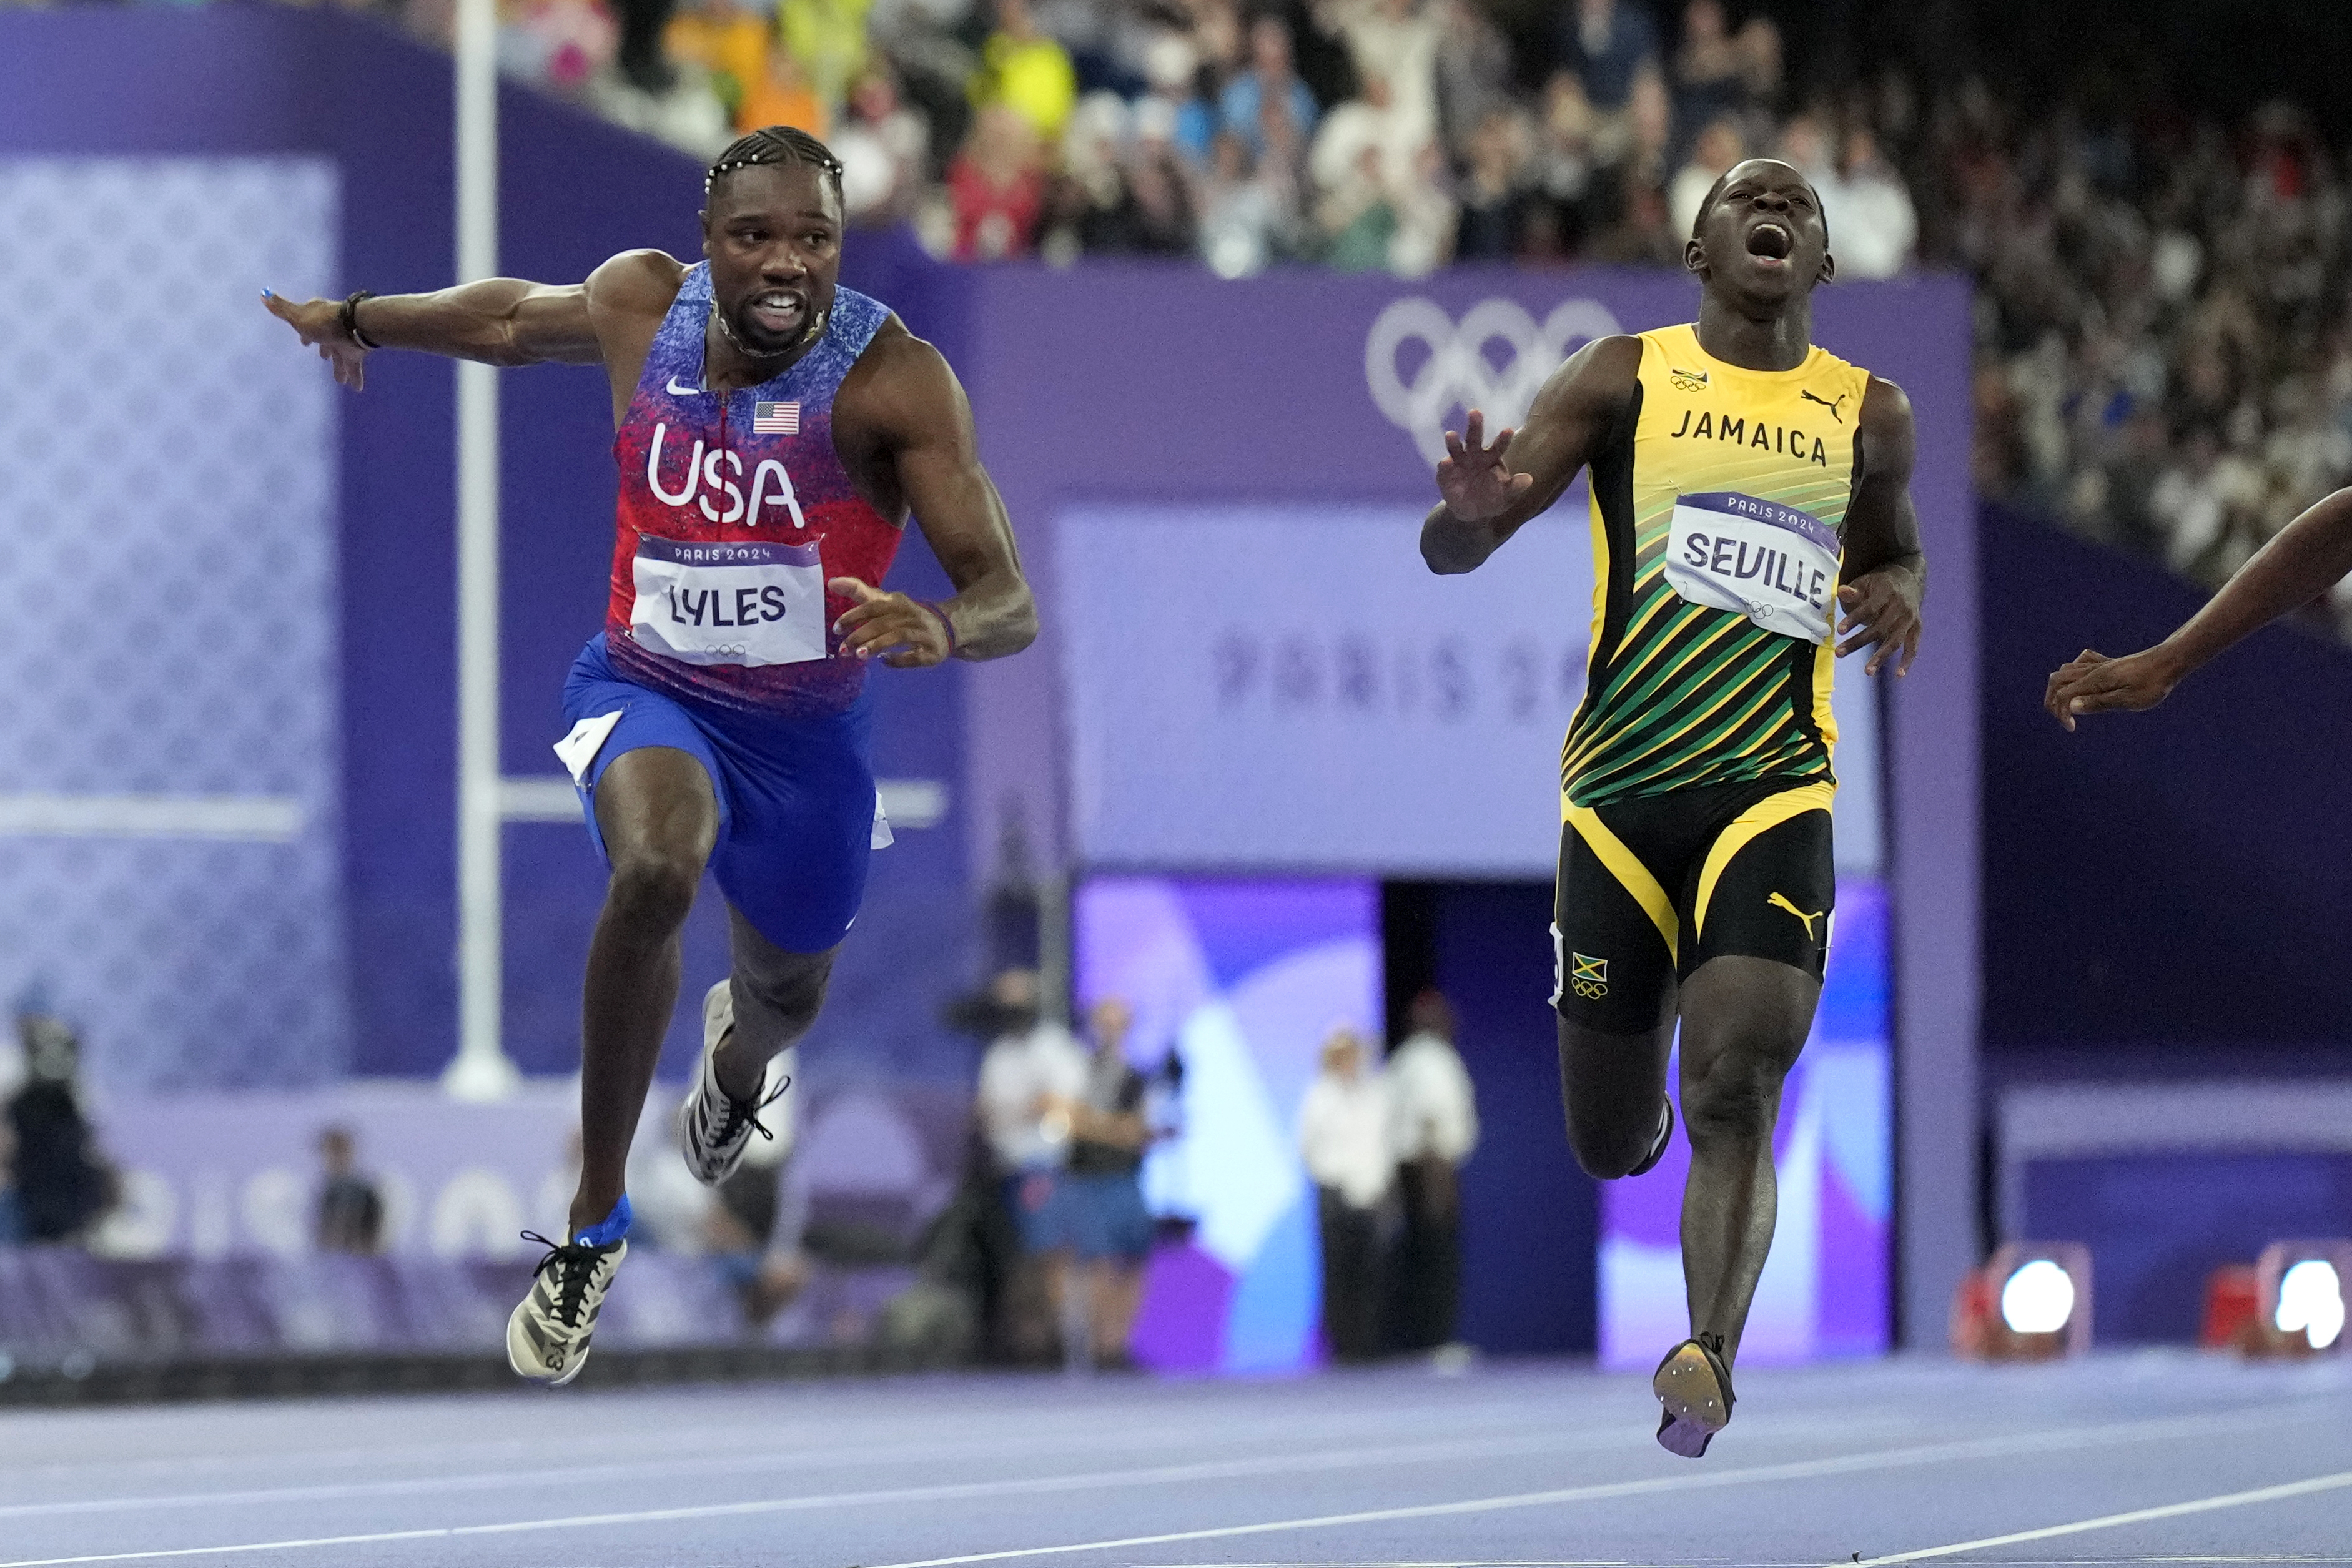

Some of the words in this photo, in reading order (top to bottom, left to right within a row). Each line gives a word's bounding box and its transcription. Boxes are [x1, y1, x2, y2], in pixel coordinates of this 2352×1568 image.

[1670, 410, 1826, 468] JAMAICA
[648, 422, 806, 529] USA
[1727, 496, 1774, 518] PARIS
[1779, 511, 1814, 534] 2024
[674, 547, 719, 561] PARIS
[726, 547, 771, 560] 2024
[1683, 532, 1826, 611] SEVILLE
[668, 584, 786, 627] LYLES
[1213, 629, 1472, 724] PARIS
